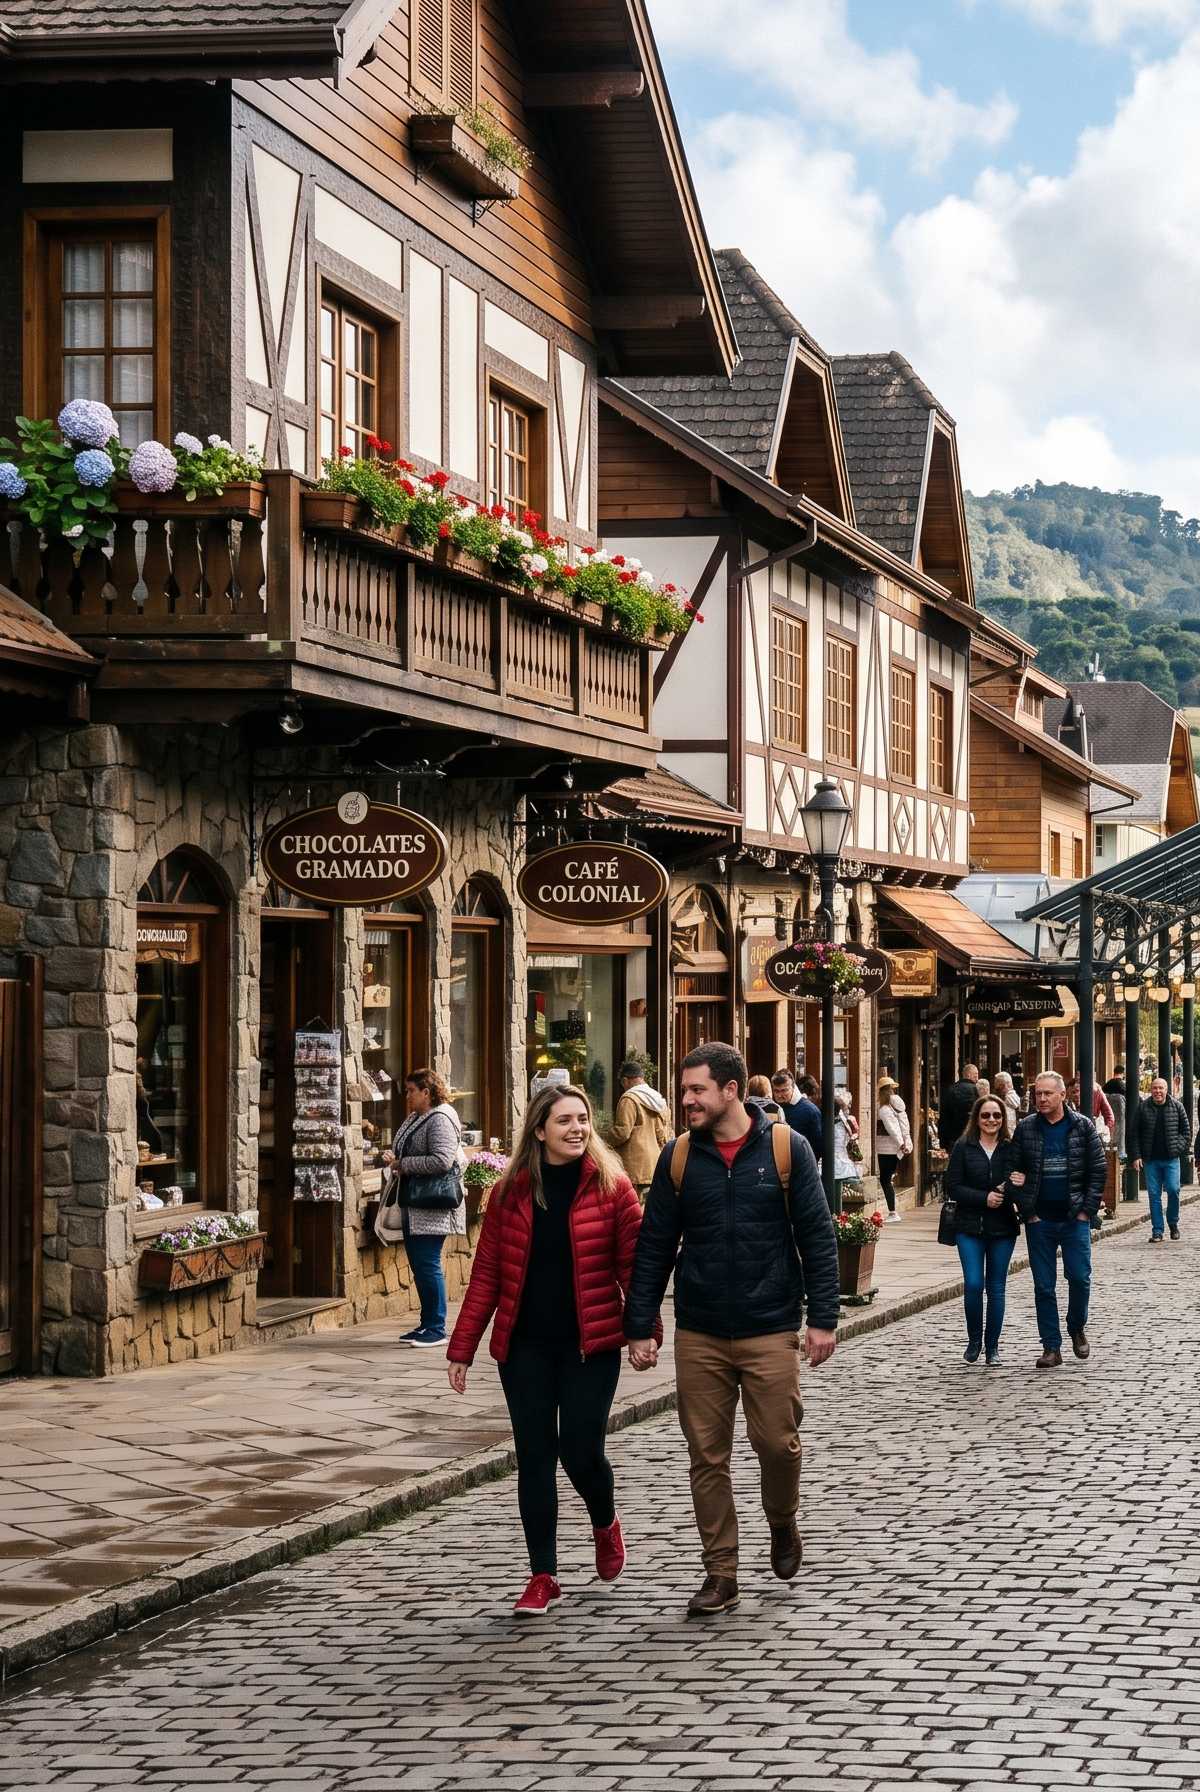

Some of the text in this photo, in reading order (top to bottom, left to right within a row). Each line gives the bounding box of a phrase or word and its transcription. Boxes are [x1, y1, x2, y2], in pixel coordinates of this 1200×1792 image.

[280, 835, 426, 854] CHOCOLATES
[296, 859, 410, 879] GRAMADO
[564, 857, 619, 879] CAFÉ
[538, 885, 646, 903] COLONIAL
